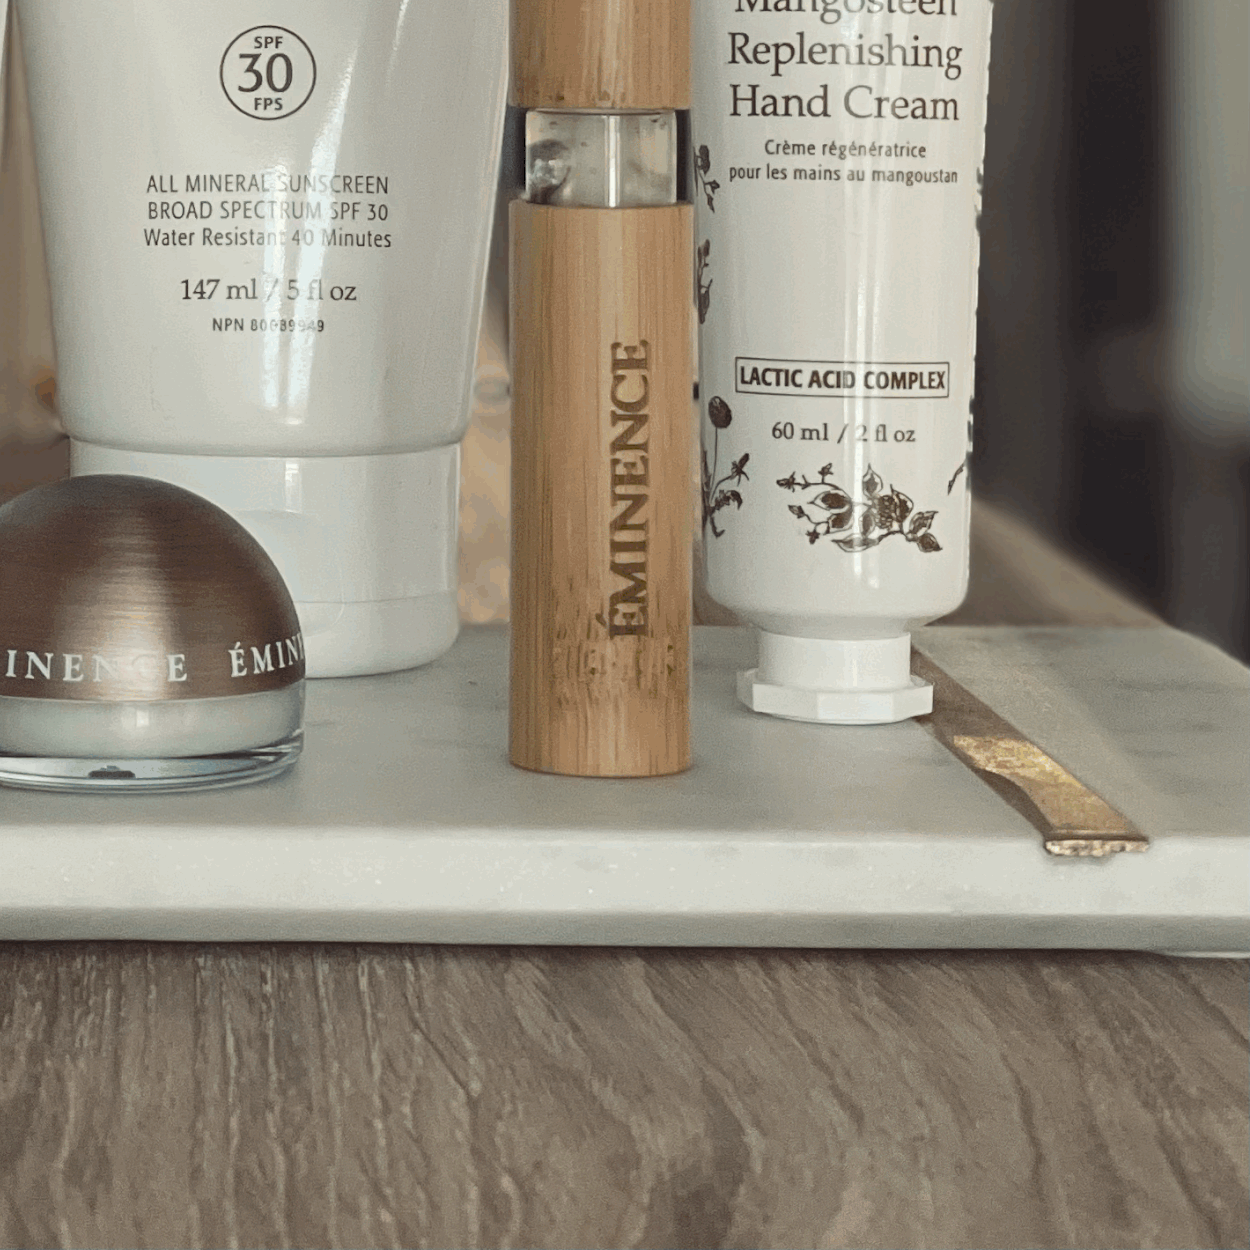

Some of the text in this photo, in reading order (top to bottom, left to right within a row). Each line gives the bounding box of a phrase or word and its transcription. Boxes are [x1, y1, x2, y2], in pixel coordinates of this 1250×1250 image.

[254, 36, 284, 50] SPF
[727, 32, 963, 81] Replenishing
[237, 53, 294, 94] 30
[254, 97, 284, 112] FPS
[729, 85, 960, 121] Hand Cream
[764, 139, 926, 160] Crème régénératrice
[146, 175, 389, 195] ALL MINERAL SUNSCREEN
[729, 164, 958, 185] pour les mains au mangoustan
[148, 201, 389, 222] BROAD SPECTRUM SPF 30
[144, 228, 195, 246] Water
[292, 229, 314, 247] 40
[322, 228, 393, 248] Minutes
[180, 278, 357, 303] 147 ml / 5 fl oz
[212, 318, 244, 332] NPN
[740, 366, 946, 390] LACTIC ACID COMPLEX
[771, 421, 916, 444] 60 ml / 2 fl oz
[596, 338, 651, 638] ÉMINENCE
